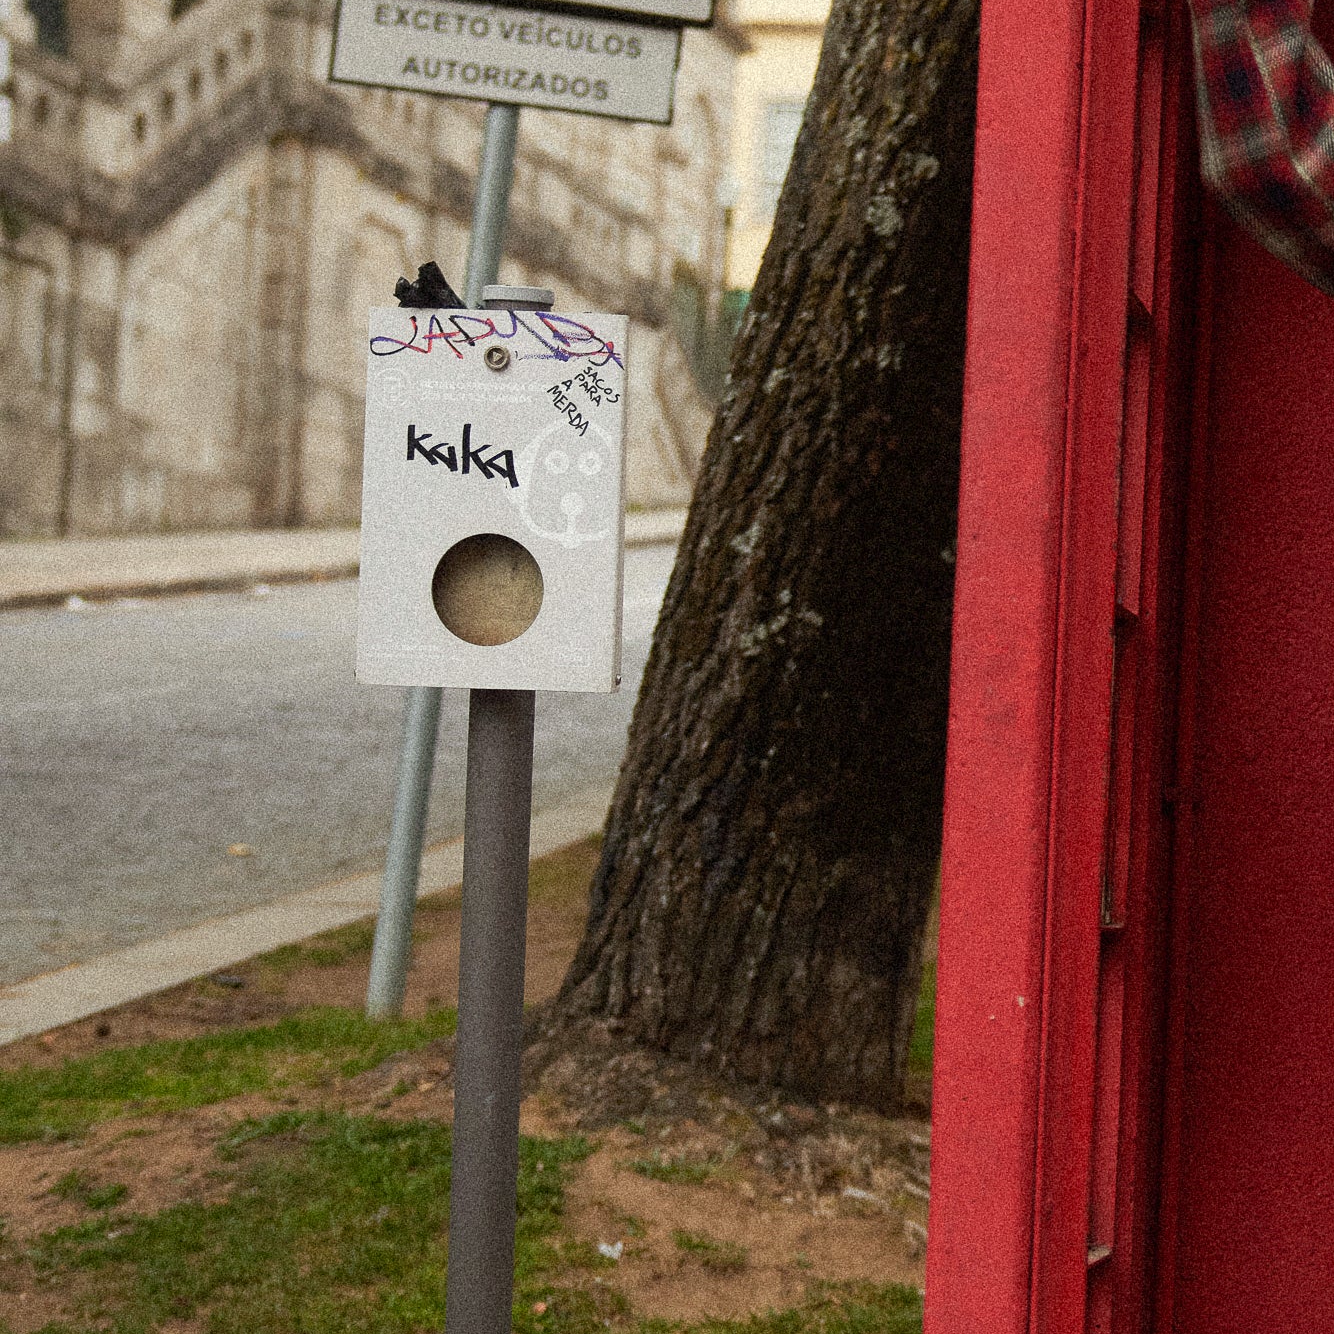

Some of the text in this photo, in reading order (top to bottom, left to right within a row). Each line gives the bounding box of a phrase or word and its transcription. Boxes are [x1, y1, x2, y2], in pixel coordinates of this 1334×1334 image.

[374, 2, 491, 38] EXCETO
[402, 55, 611, 102] AUTORIZADOS
[561, 379, 573, 392] A
[574, 373, 601, 407] PARA
[583, 367, 620, 403] SACOS
[547, 385, 590, 437] MERDA
